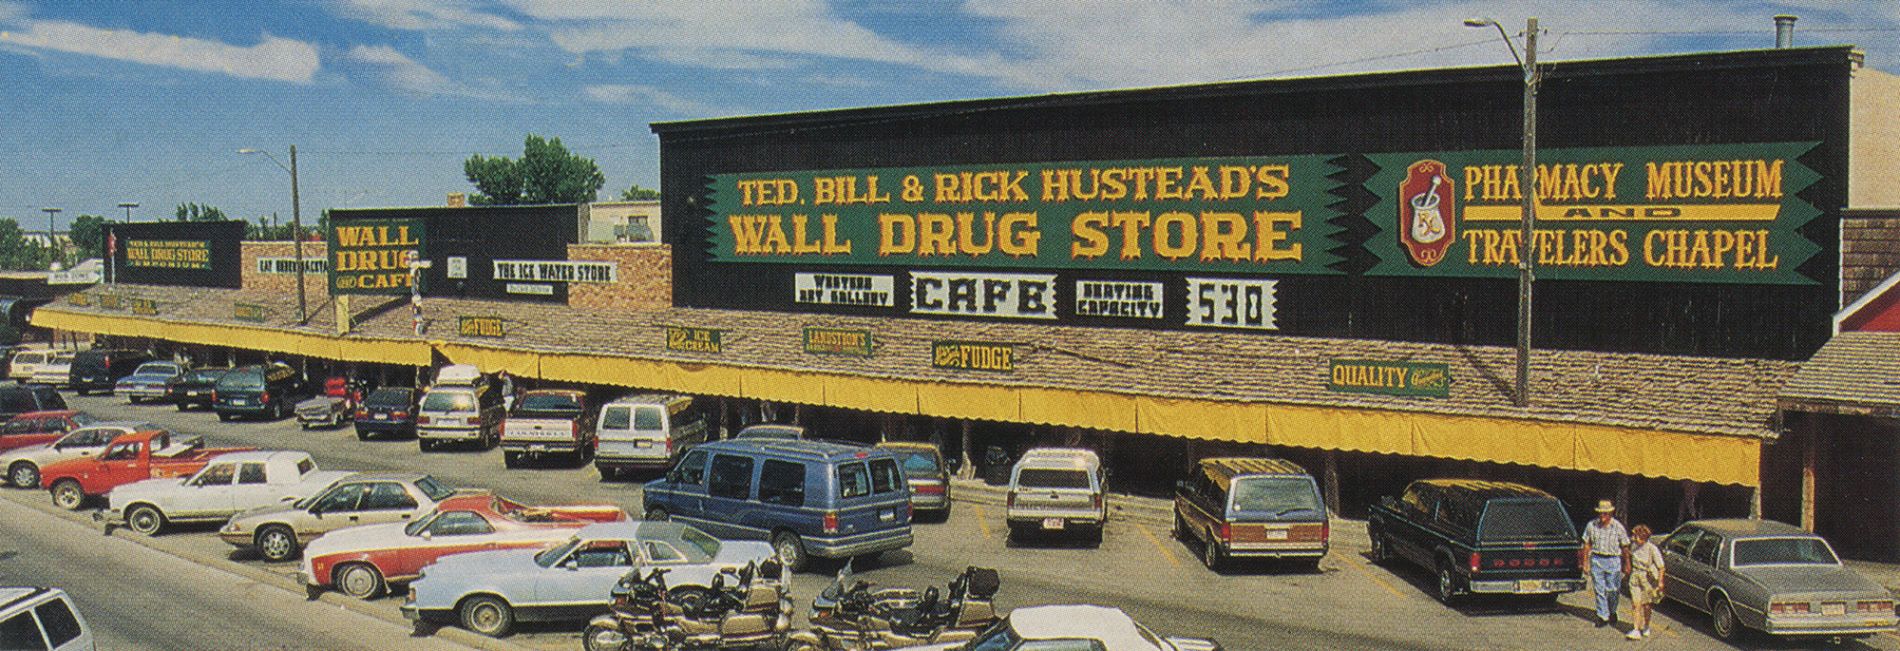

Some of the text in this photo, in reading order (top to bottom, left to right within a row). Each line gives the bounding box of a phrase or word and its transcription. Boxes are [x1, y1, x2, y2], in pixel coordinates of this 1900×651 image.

[737, 164, 1290, 206] TED. BILL & RICK HUSTEAD'S
[1645, 159, 1784, 200] MUSEUM
[1563, 207, 1682, 219] AND
[336, 225, 419, 247] WALL
[728, 210, 1302, 263] WALL DRUG STORE
[127, 247, 209, 262] WALL DRUG STORE
[1643, 228, 1779, 269] CHAPEL
[497, 263, 611, 281] THE ICE WATER STORE
[814, 274, 873, 290] WESTERN
[799, 289, 889, 305] ART GALLERY
[916, 277, 1048, 314] CAFE
[1083, 283, 1154, 299] SEATING
[1077, 299, 1161, 317] CAPACITY
[1198, 282, 1263, 325] 530
[960, 344, 1013, 371] FUDGE
[1332, 364, 1408, 389] QUALITY
